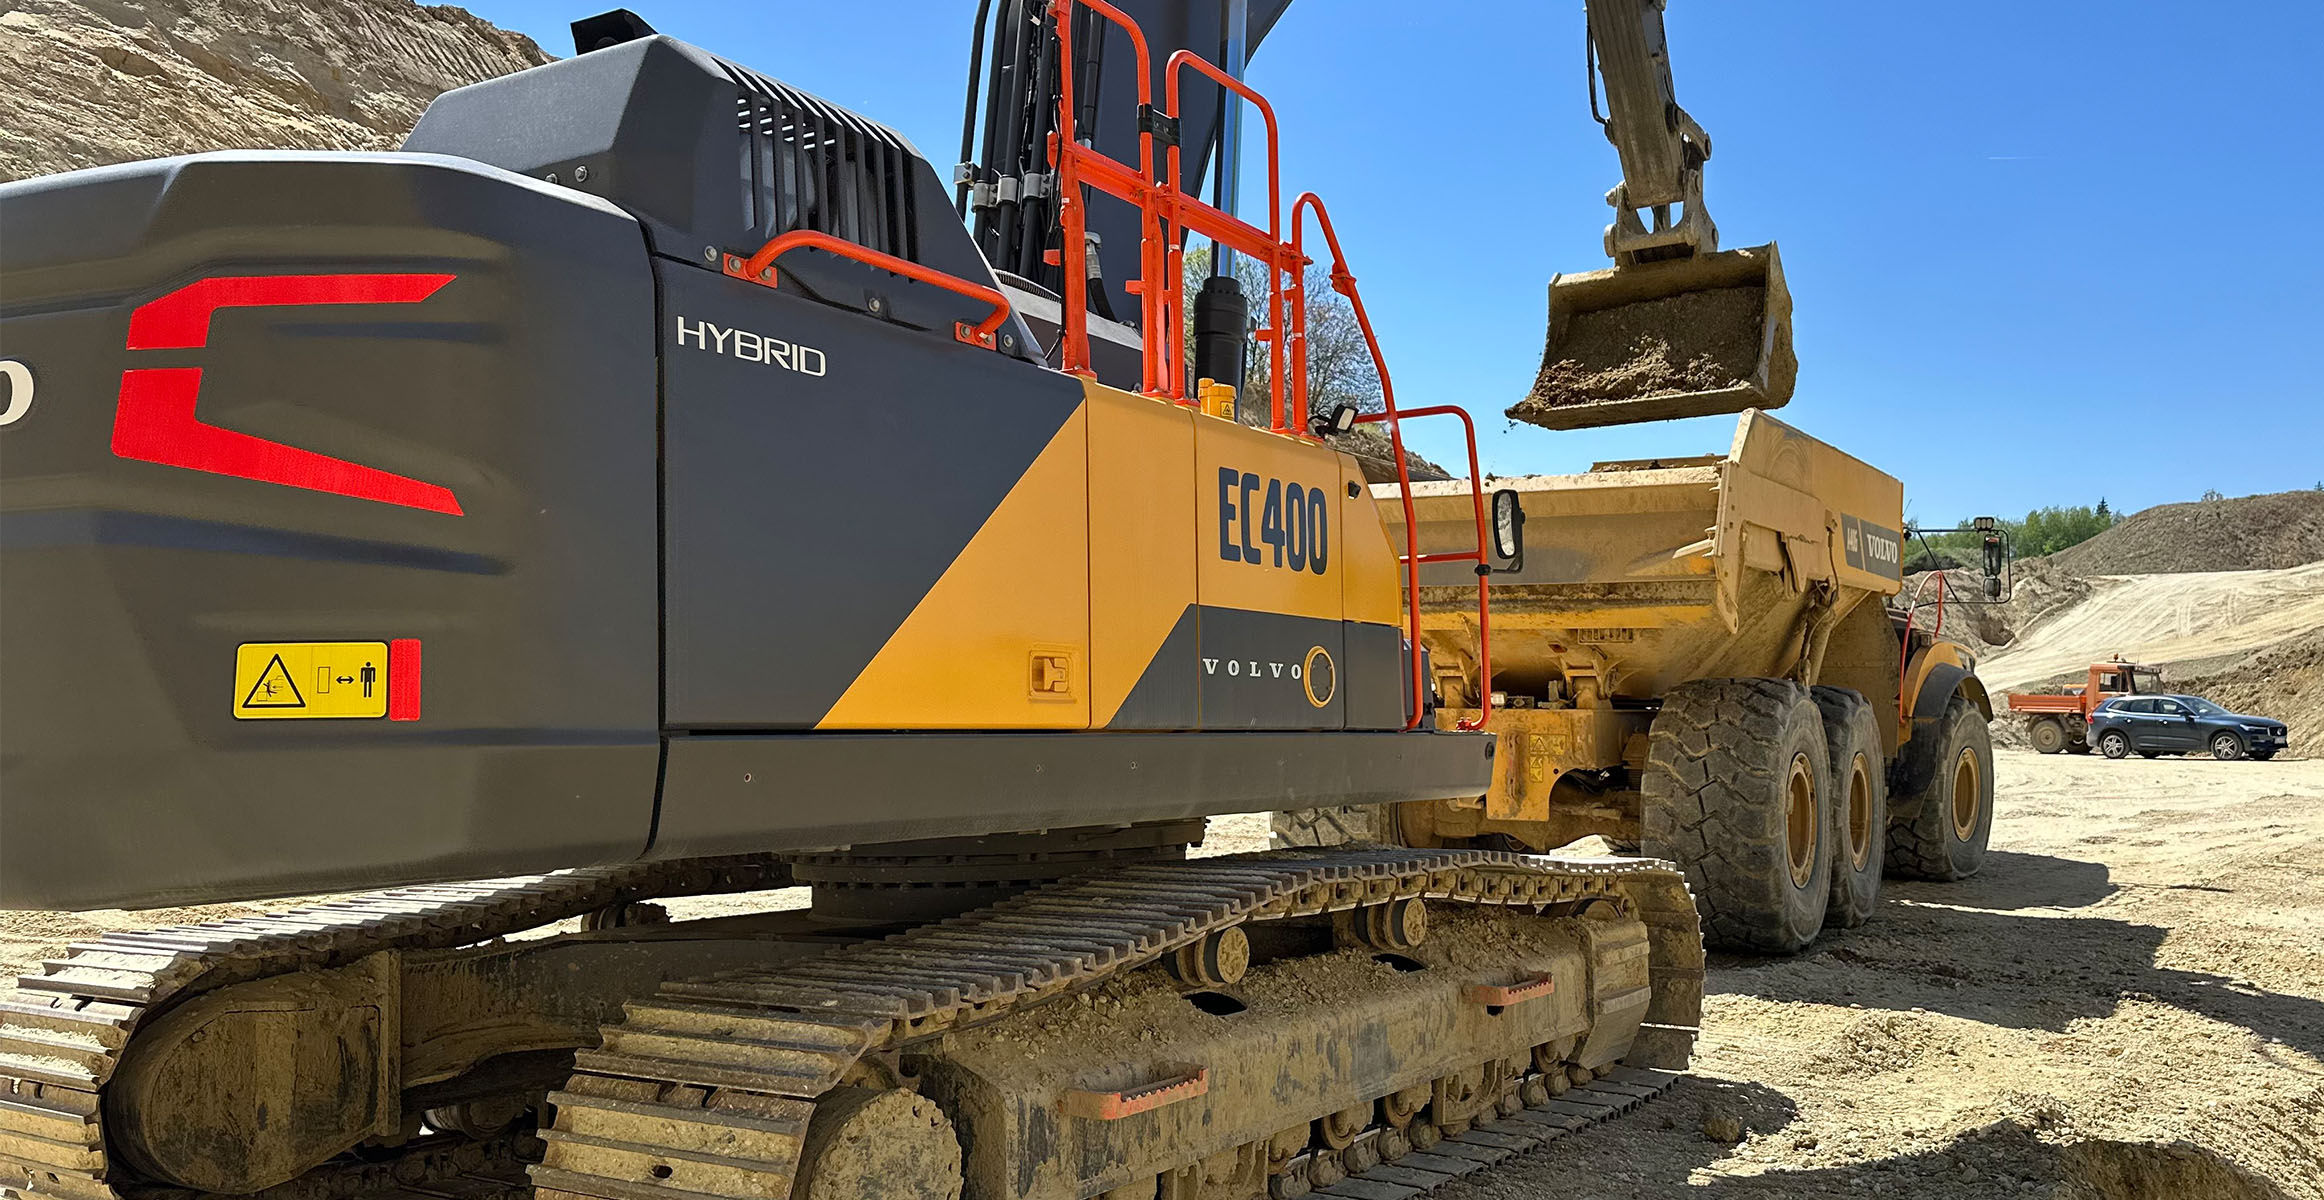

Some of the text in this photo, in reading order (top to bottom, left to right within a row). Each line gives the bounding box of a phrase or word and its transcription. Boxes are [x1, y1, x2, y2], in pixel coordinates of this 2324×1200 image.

[677, 315, 827, 377] HYBRID
[1218, 466, 1328, 576] EC400
[1866, 533, 1898, 564] VOLVO
[1203, 658, 1302, 680] VOLVO
